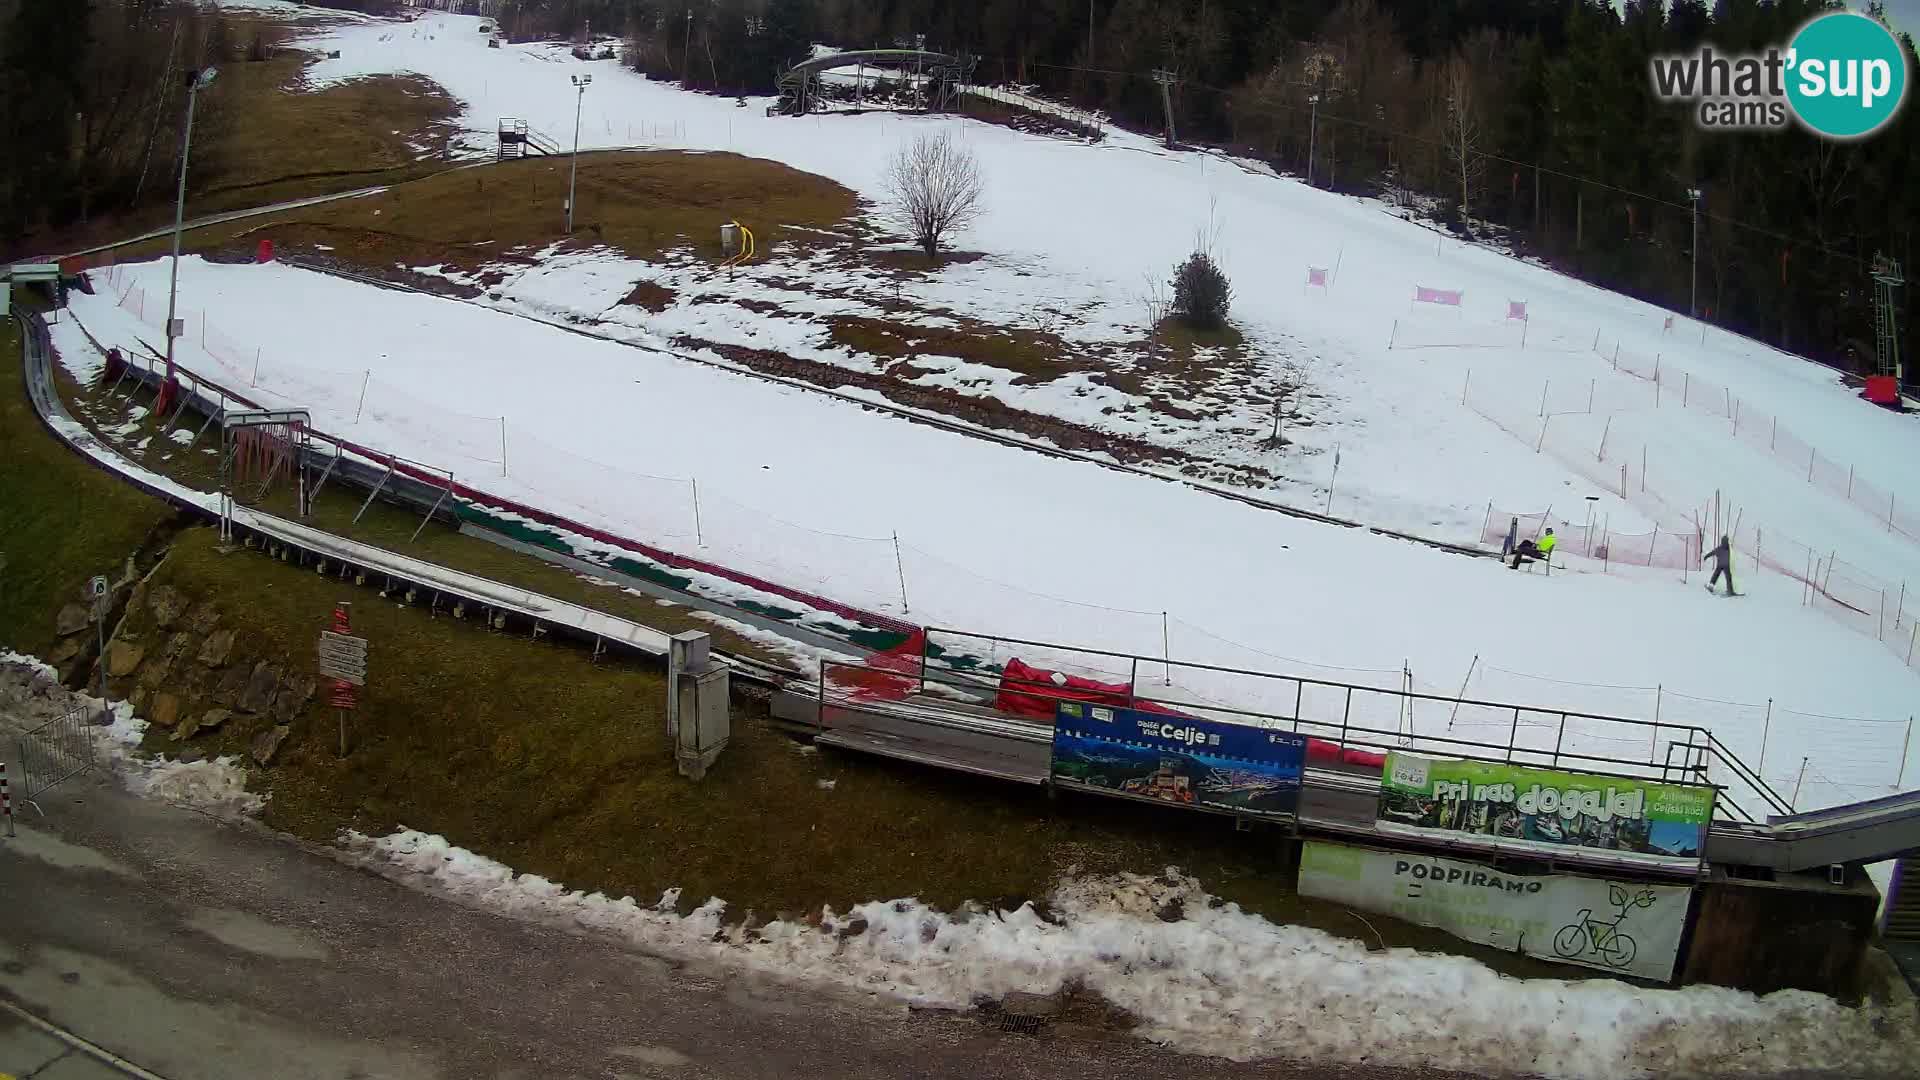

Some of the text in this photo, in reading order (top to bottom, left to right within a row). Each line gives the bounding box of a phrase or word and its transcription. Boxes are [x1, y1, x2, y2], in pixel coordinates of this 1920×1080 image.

[1160, 723, 1206, 746] Celje
[1433, 779, 1469, 801] Pri
[1473, 782, 1515, 803] nas
[1516, 783, 1645, 822] dogaja!
[1394, 860, 1543, 894] PODPIRAMO
